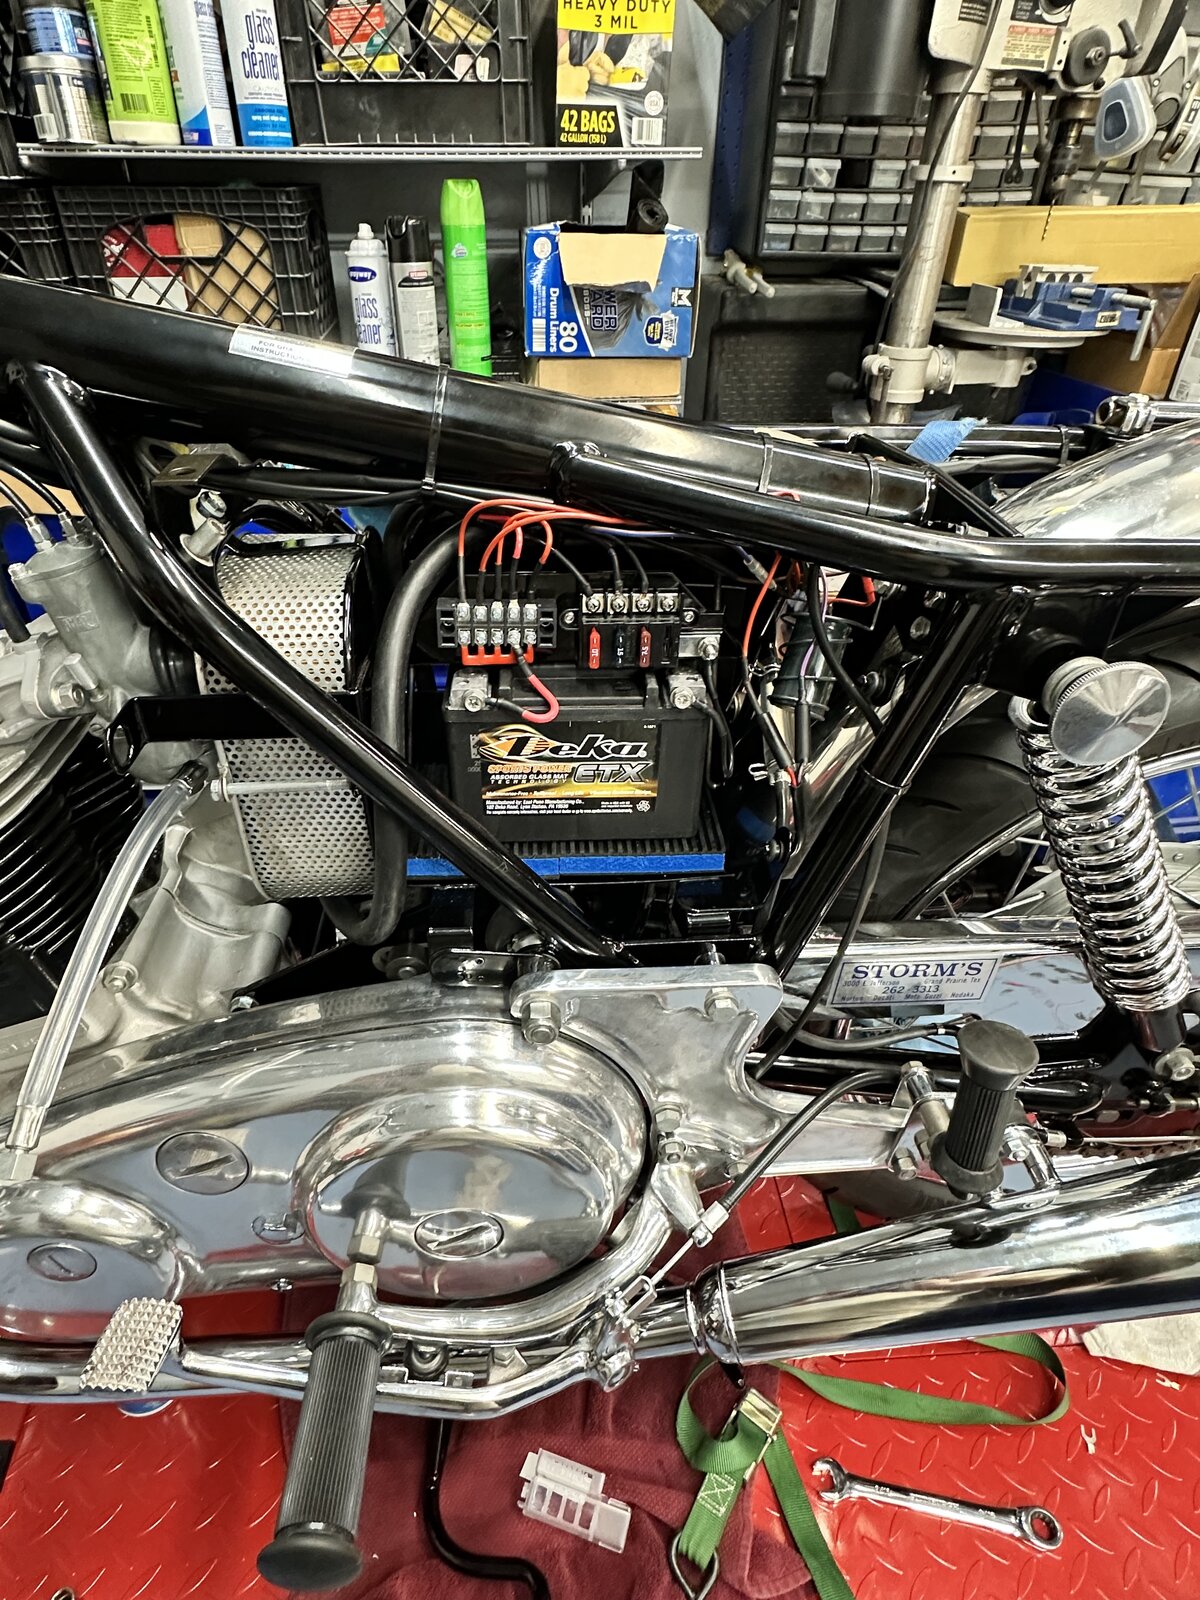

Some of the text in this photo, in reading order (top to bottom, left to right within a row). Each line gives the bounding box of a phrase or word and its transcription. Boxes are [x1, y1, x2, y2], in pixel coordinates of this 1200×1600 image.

[563, 0, 671, 13] HEAVY DUTY
[245, 10, 275, 50] glass
[594, 14, 638, 29] 3 MIL
[241, 48, 280, 80] cleaner
[560, 109, 616, 133] 42 BAGS
[549, 287, 560, 353] Drum Liners
[590, 289, 605, 330] ARD
[604, 290, 618, 330] WER
[559, 321, 578, 353] 80
[499, 733, 648, 760] Deka
[851, 962, 983, 979] STORM'S
[882, 986, 905, 994] 262
